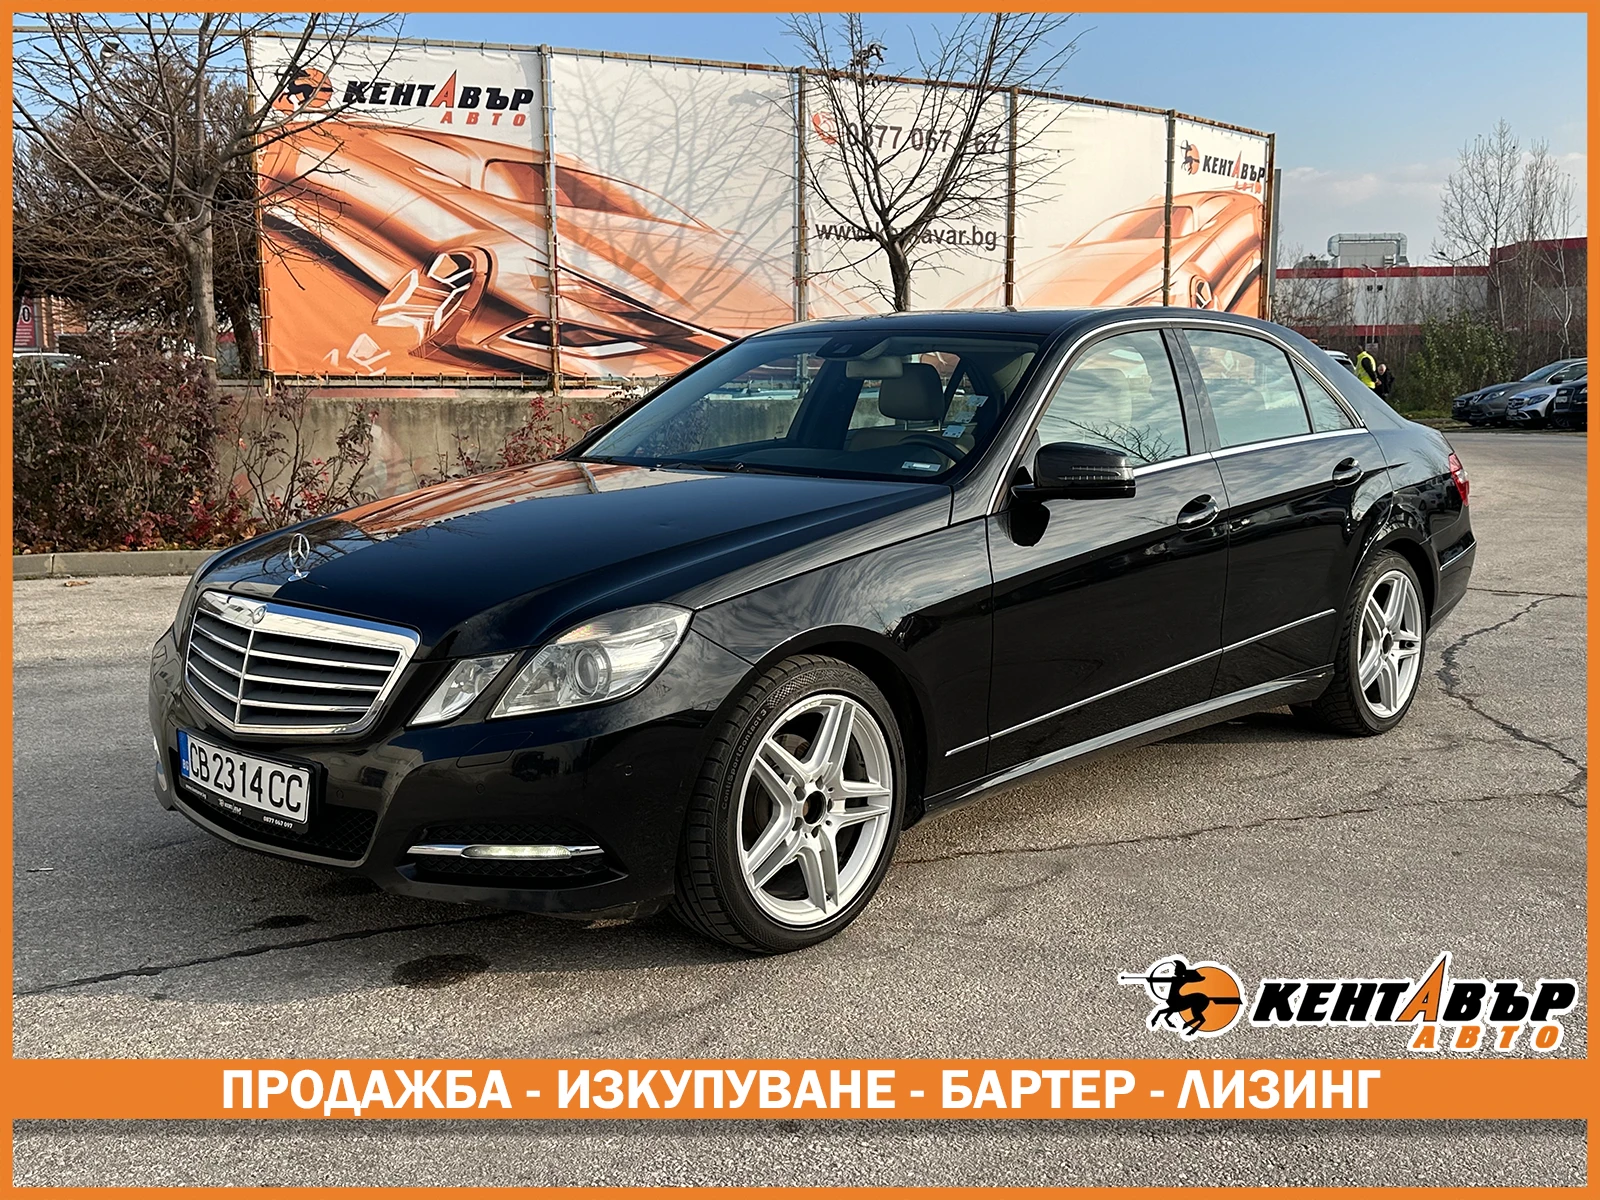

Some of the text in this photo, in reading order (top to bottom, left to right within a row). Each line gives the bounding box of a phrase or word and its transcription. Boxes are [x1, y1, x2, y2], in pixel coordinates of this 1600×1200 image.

[342, 69, 534, 111] КЕНТАВЪР
[440, 111, 526, 127] АВТО
[911, 127, 953, 153] 067
[1202, 150, 1266, 182] КЕНТАВЪР
[722, 715, 763, 809] ContiSportContact
